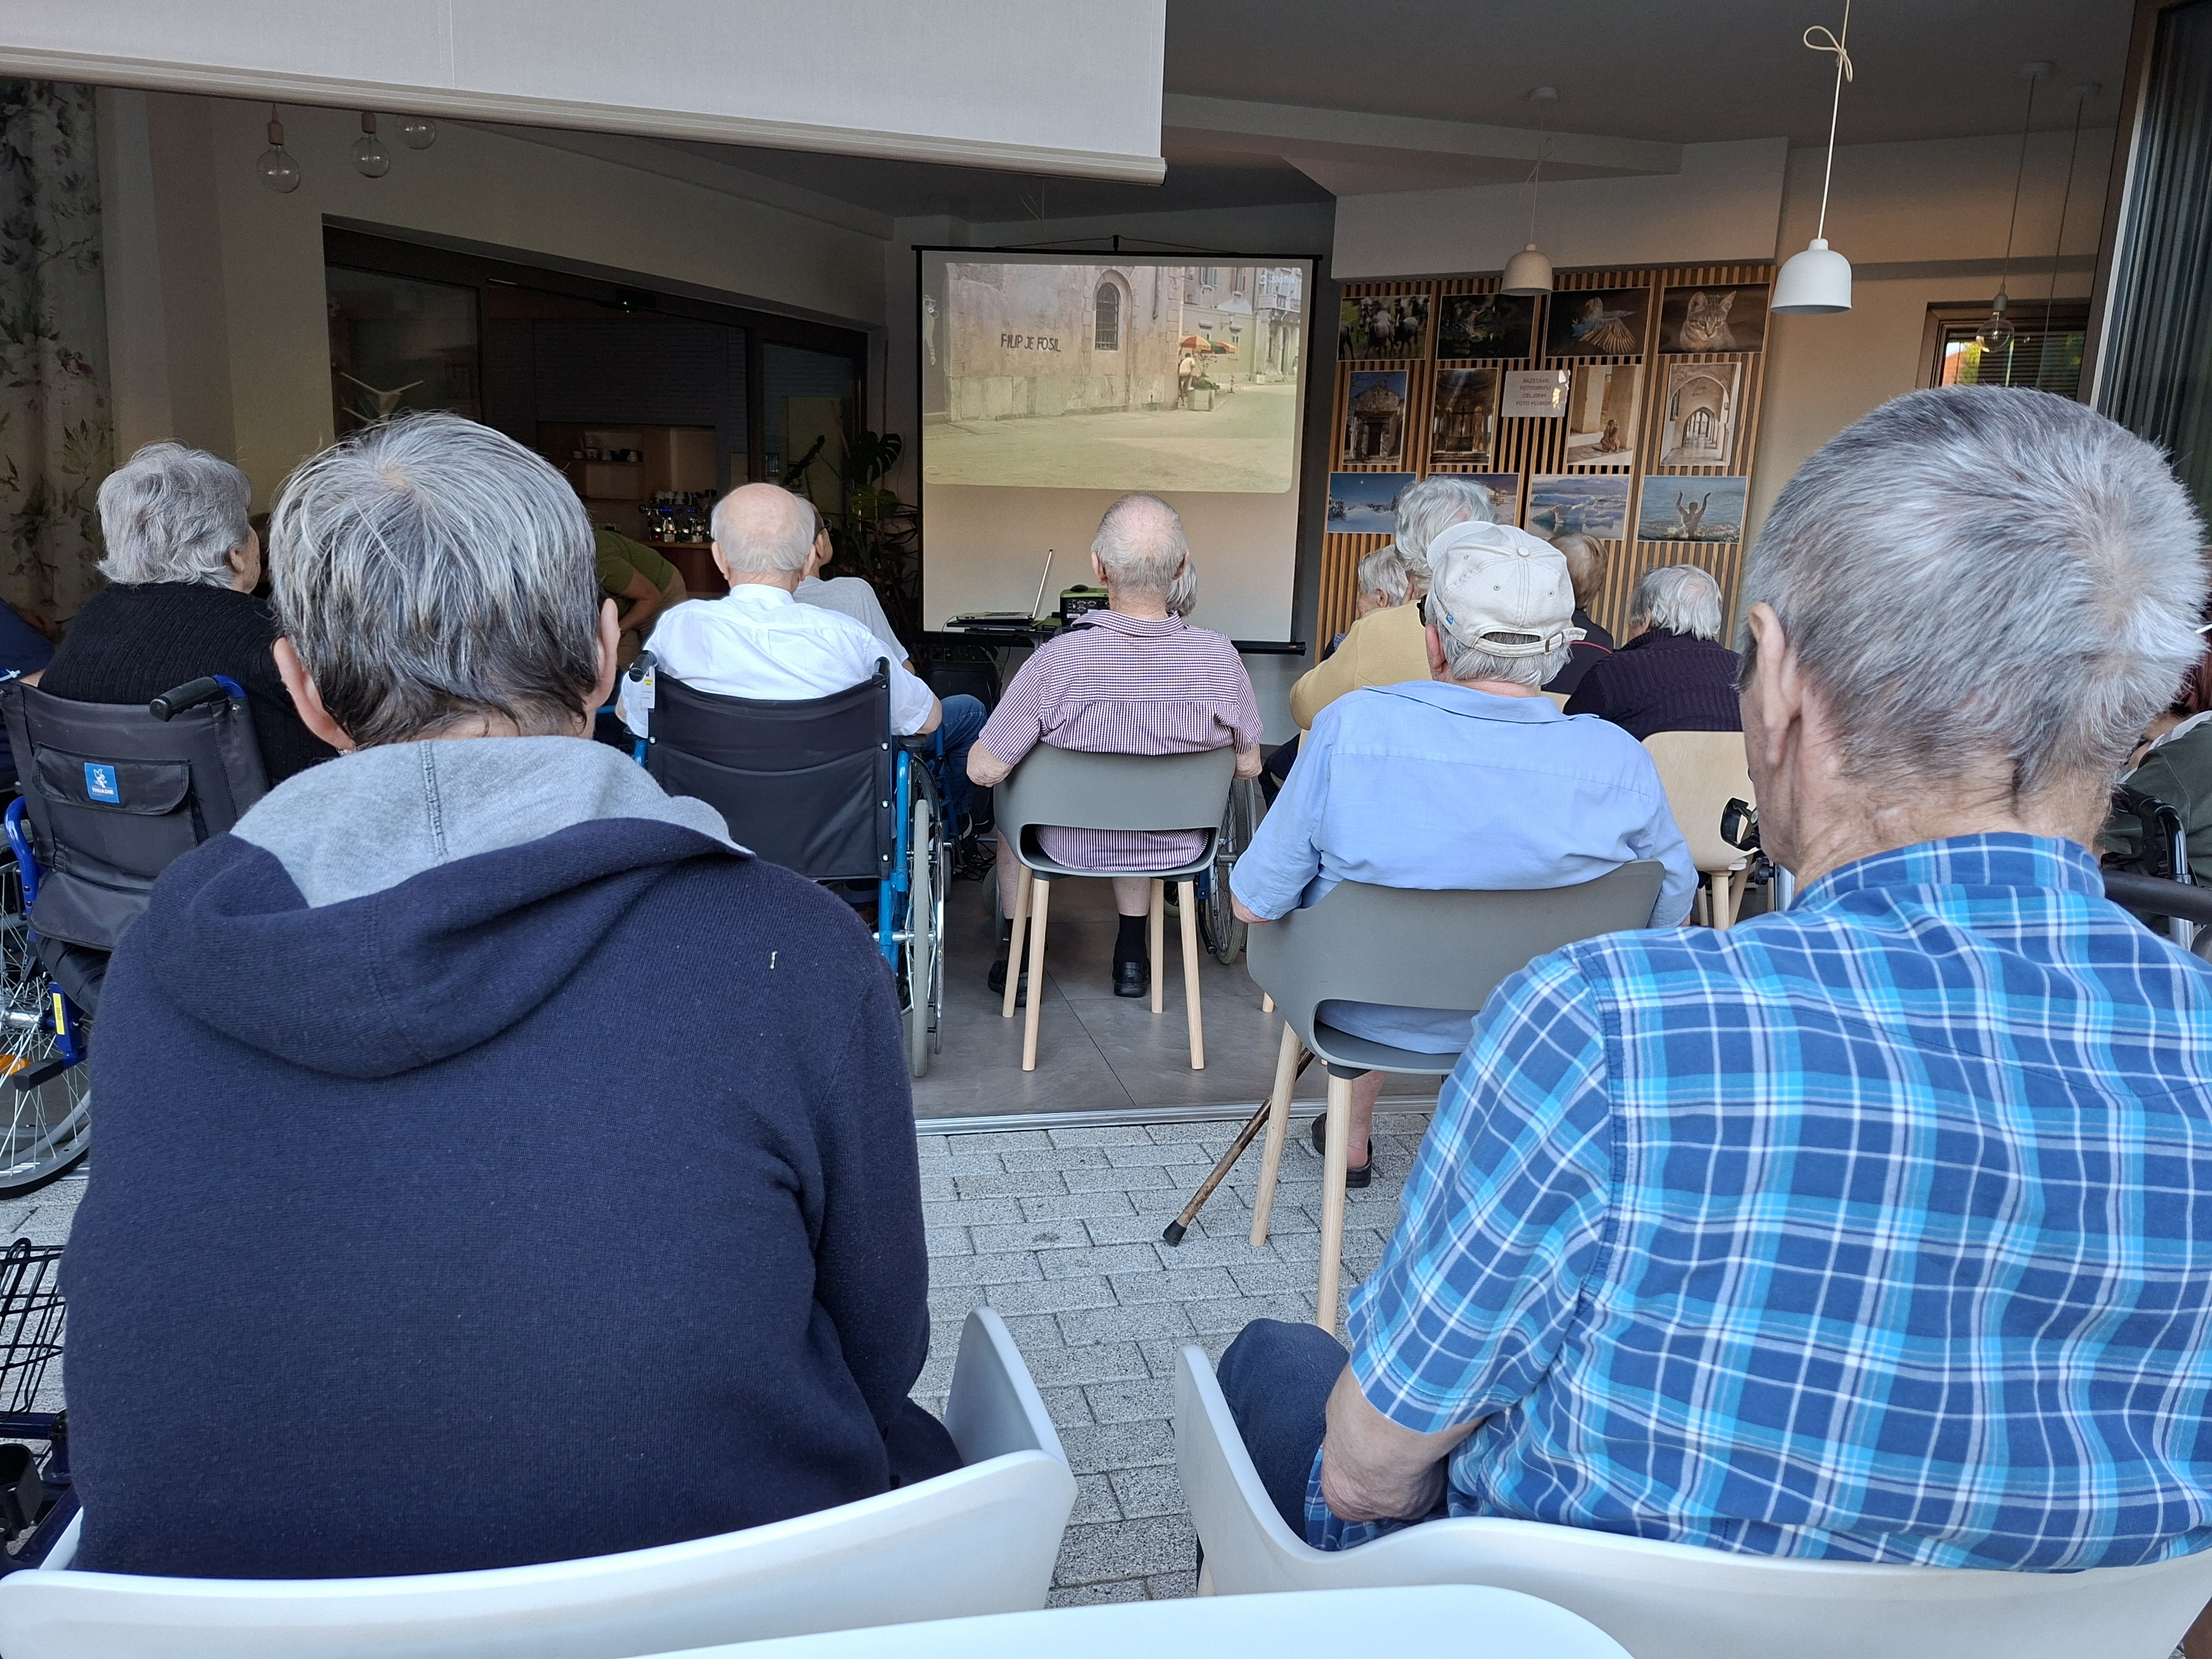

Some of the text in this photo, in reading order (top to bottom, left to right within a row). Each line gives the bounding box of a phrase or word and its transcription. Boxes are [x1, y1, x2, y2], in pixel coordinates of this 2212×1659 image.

[1001, 333, 1061, 352] FILIP JE FOSIL
